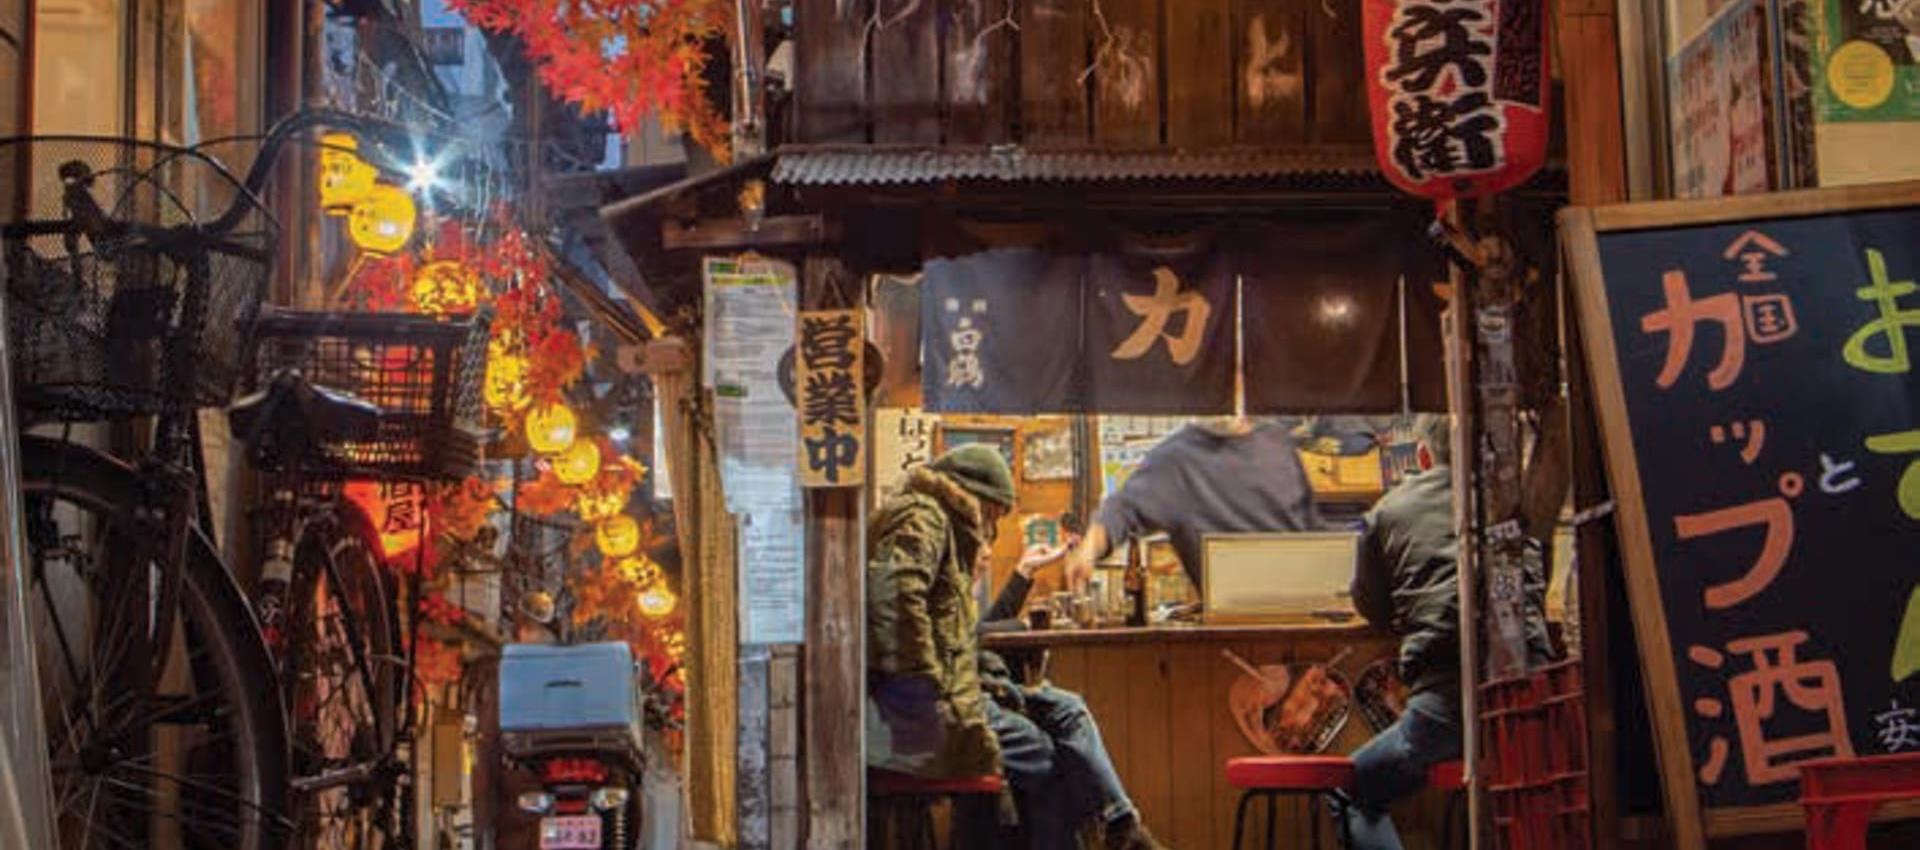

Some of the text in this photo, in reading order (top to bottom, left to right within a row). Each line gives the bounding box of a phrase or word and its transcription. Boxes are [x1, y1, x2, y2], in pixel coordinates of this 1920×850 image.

[1111, 267, 1211, 365] 力
[1725, 230, 1797, 344] 全国
[802, 315, 860, 483] 営業中
[1642, 269, 1855, 785] カップ酒
[1819, 454, 1862, 493] と
